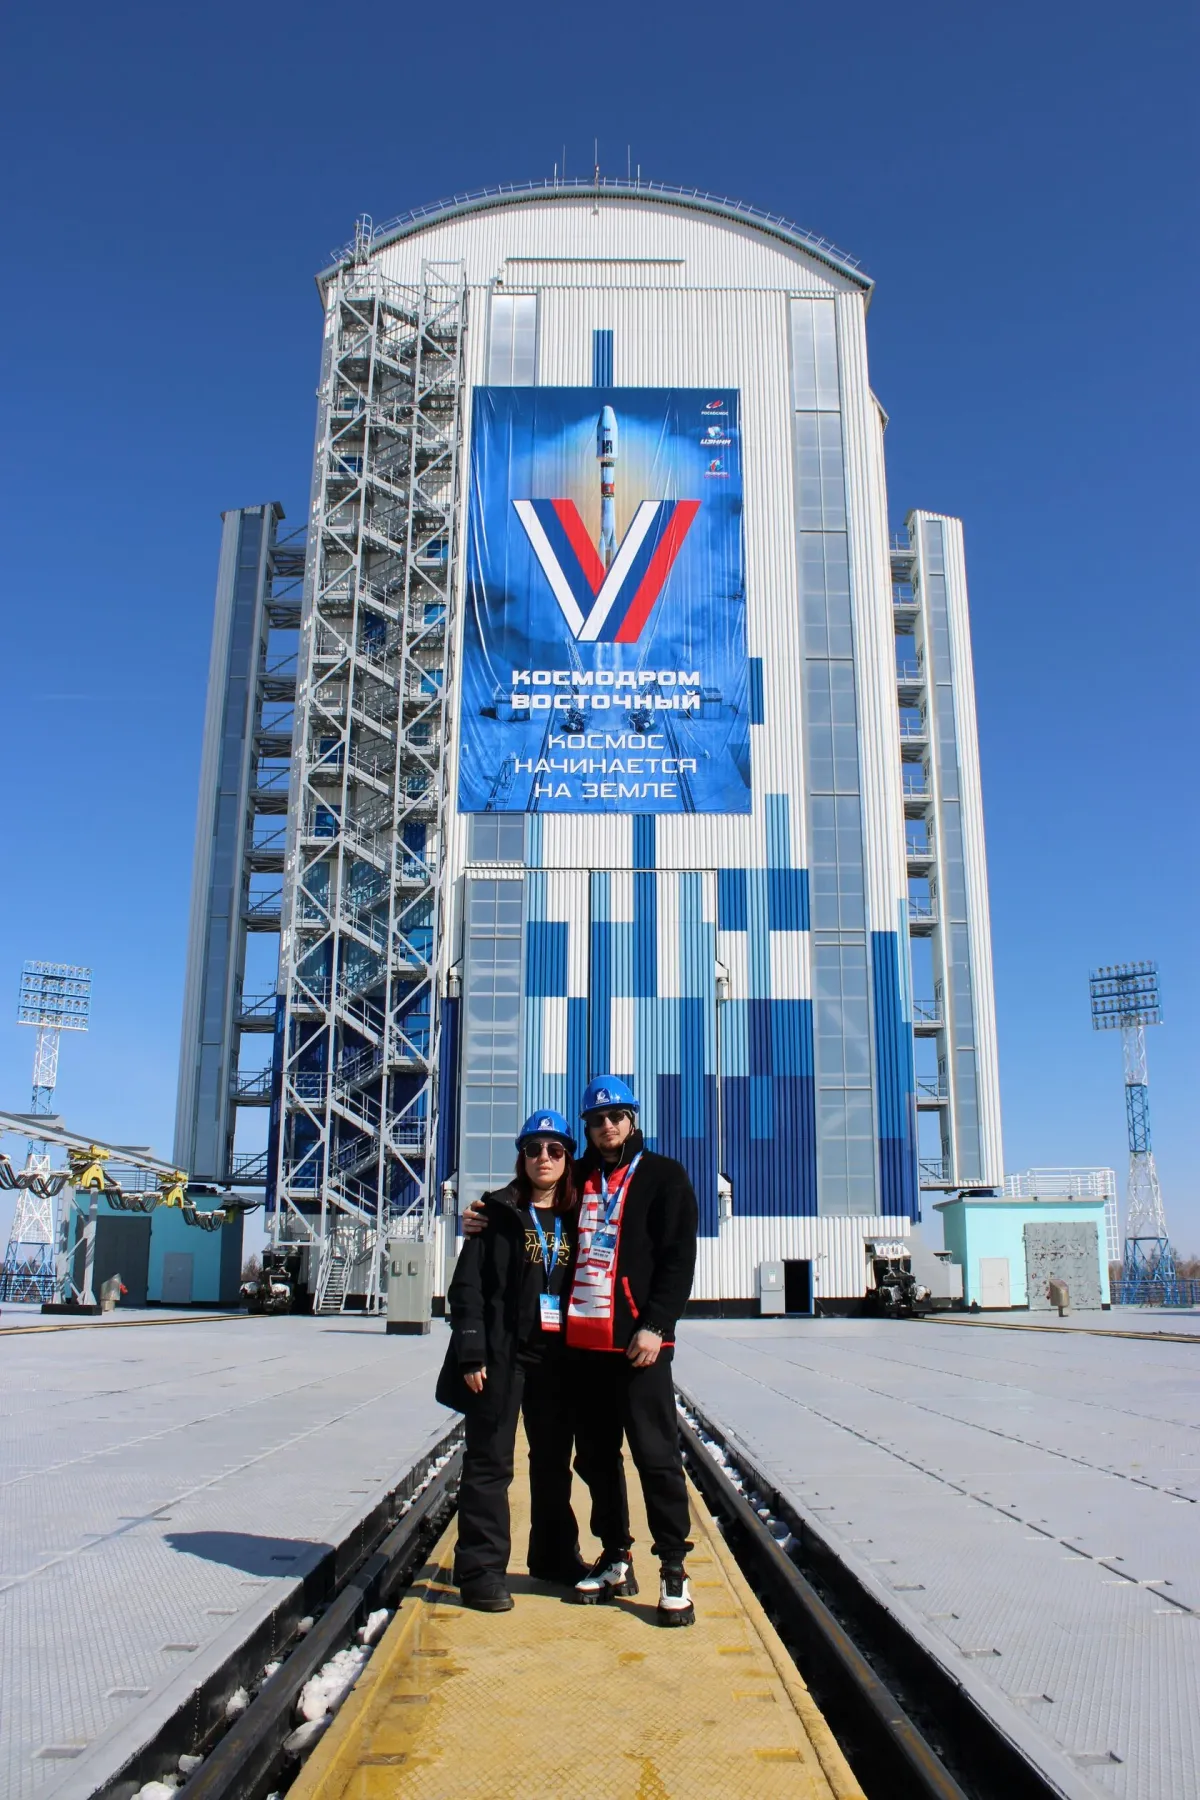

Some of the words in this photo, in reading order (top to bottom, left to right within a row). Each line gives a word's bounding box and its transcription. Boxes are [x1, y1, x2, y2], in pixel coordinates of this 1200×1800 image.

[512, 670, 700, 689] КОСМОДРОМ
[512, 691, 700, 709] ВОСТОЧНЫЙ
[548, 734, 664, 749] КОСМОС
[515, 758, 697, 773] НАЧИНАЕТСЯ
[535, 783, 571, 798] НА
[582, 783, 677, 798] ЗЕМЛЕ
